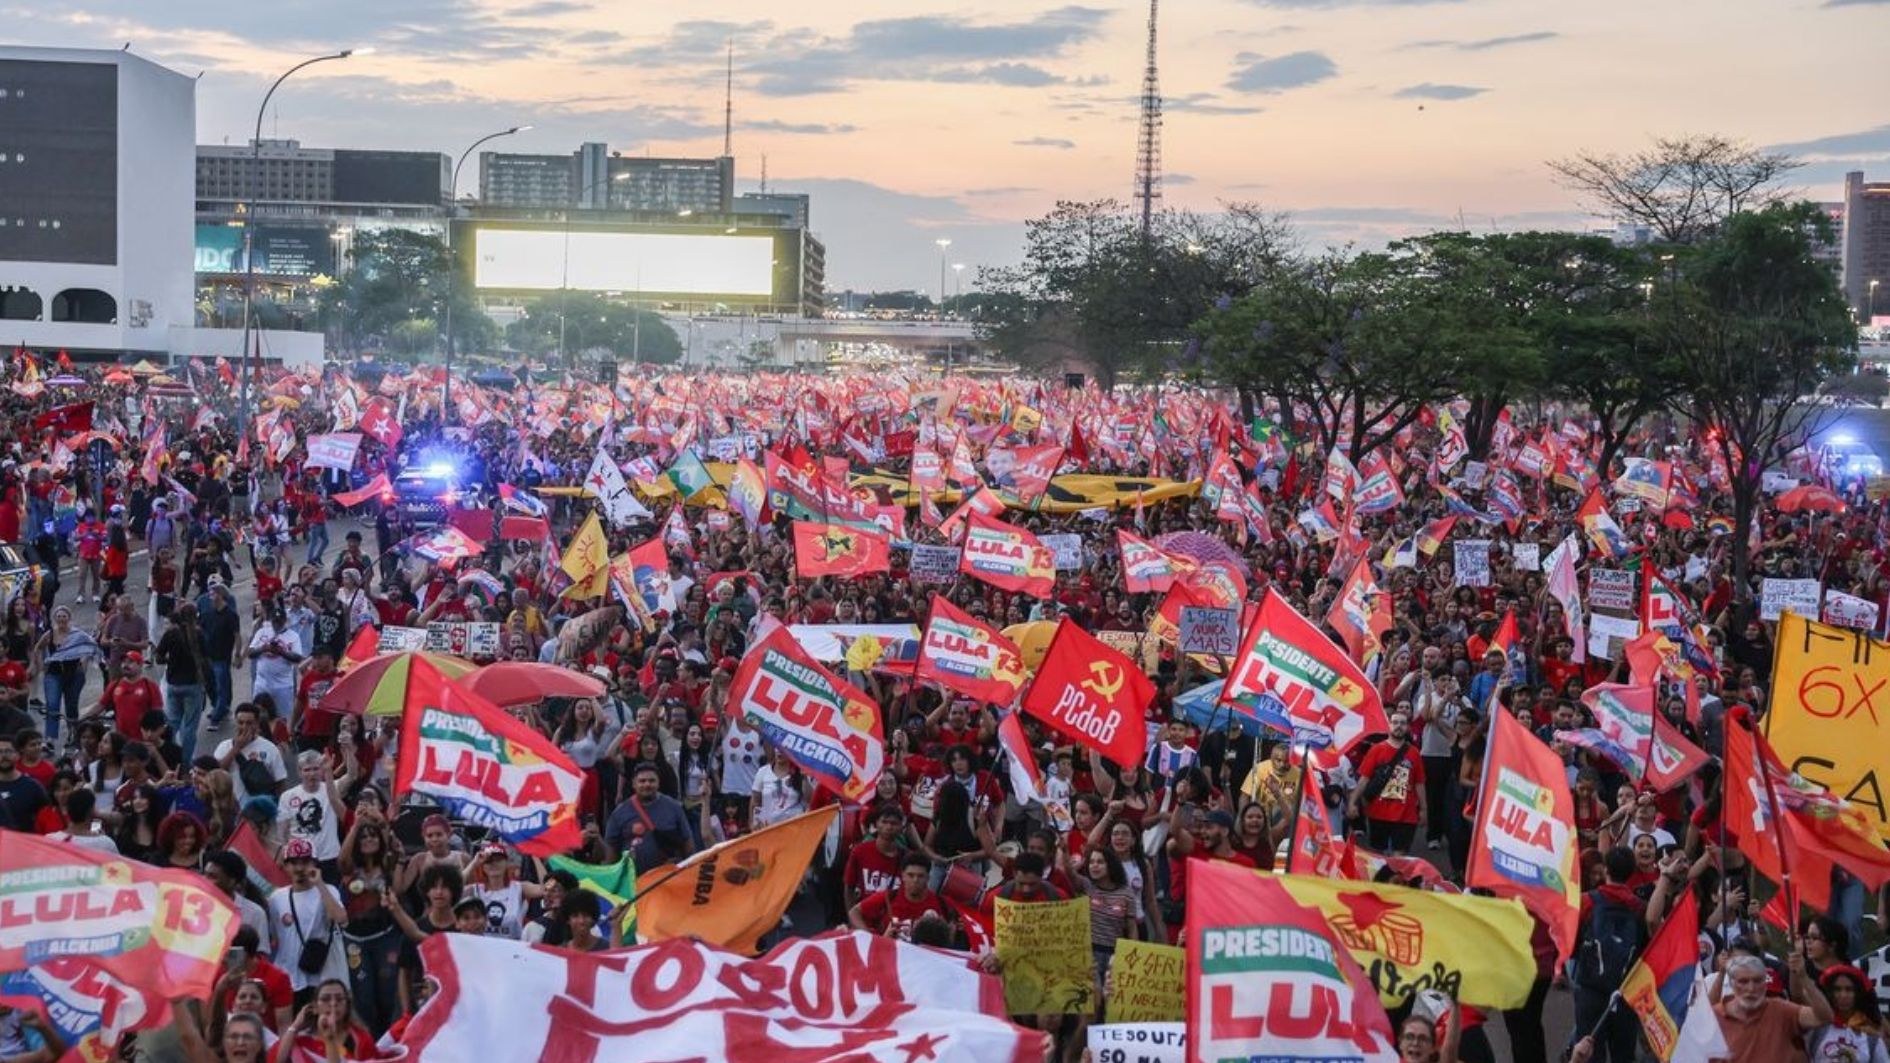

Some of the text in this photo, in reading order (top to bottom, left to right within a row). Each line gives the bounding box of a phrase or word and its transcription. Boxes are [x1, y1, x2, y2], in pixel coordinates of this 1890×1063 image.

[967, 538, 1024, 559] LULA
[1032, 547, 1055, 569] 13
[928, 631, 989, 660] LULA
[1184, 635, 1233, 651] MAIS
[751, 674, 867, 770] LULA
[1051, 683, 1122, 745] PCdoB
[418, 745, 563, 808] LULA
[1491, 795, 1555, 854] LULA
[0, 888, 145, 929] LULA
[163, 888, 214, 936] 13
